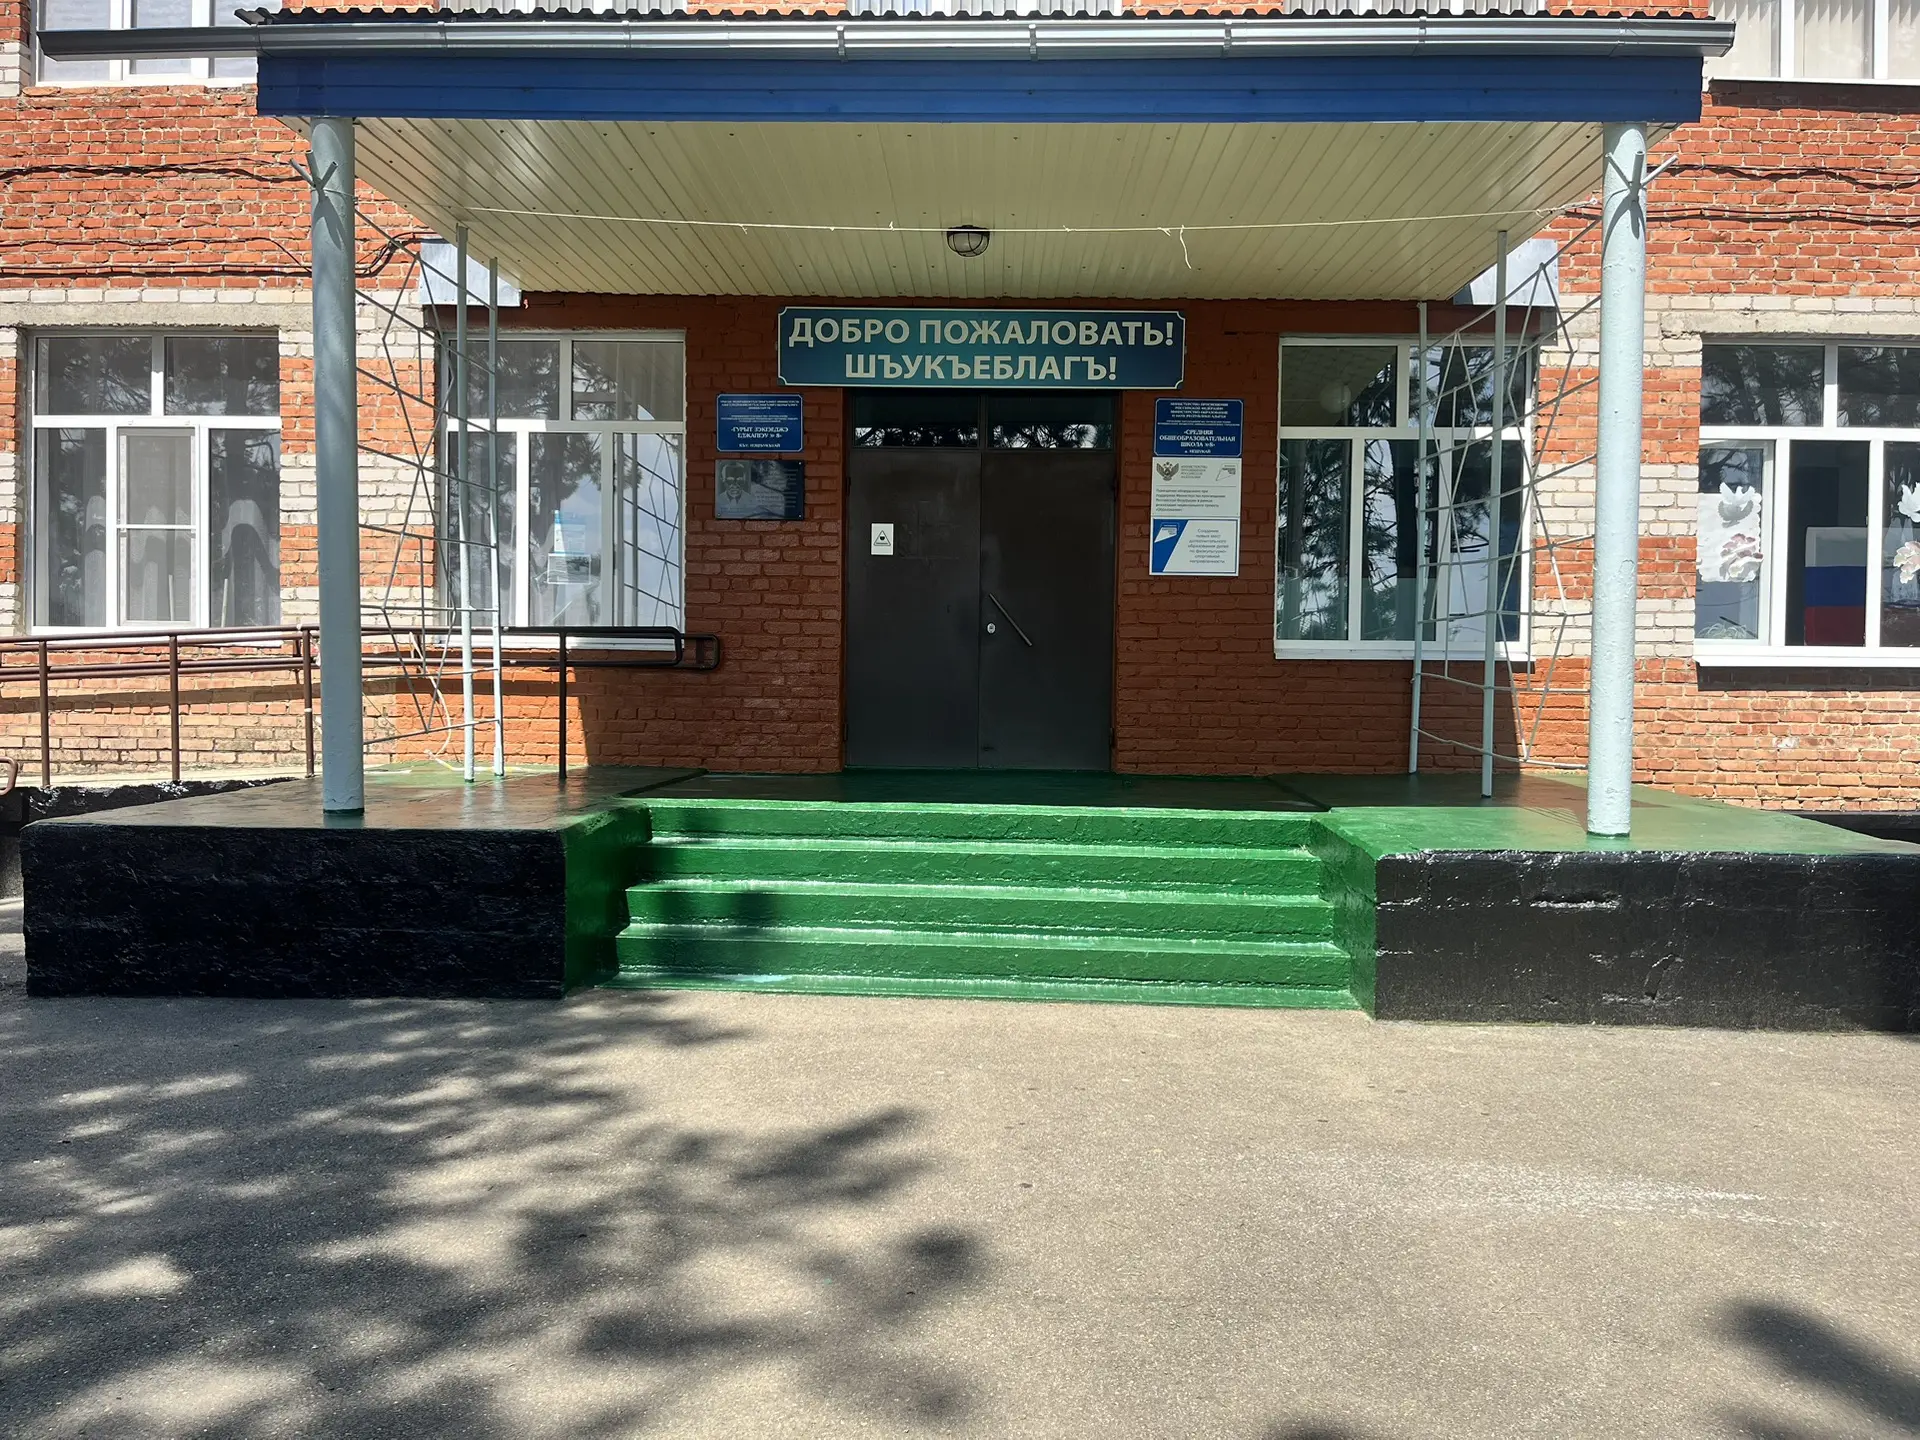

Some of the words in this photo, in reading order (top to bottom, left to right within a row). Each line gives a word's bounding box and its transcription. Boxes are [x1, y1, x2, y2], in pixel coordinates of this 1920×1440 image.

[788, 317, 910, 347] ДОБРО
[919, 319, 1174, 347] ПОЖАЛОВАТЬ!
[845, 354, 1118, 382] ШЪУКЪЕБЛАГЪ!
